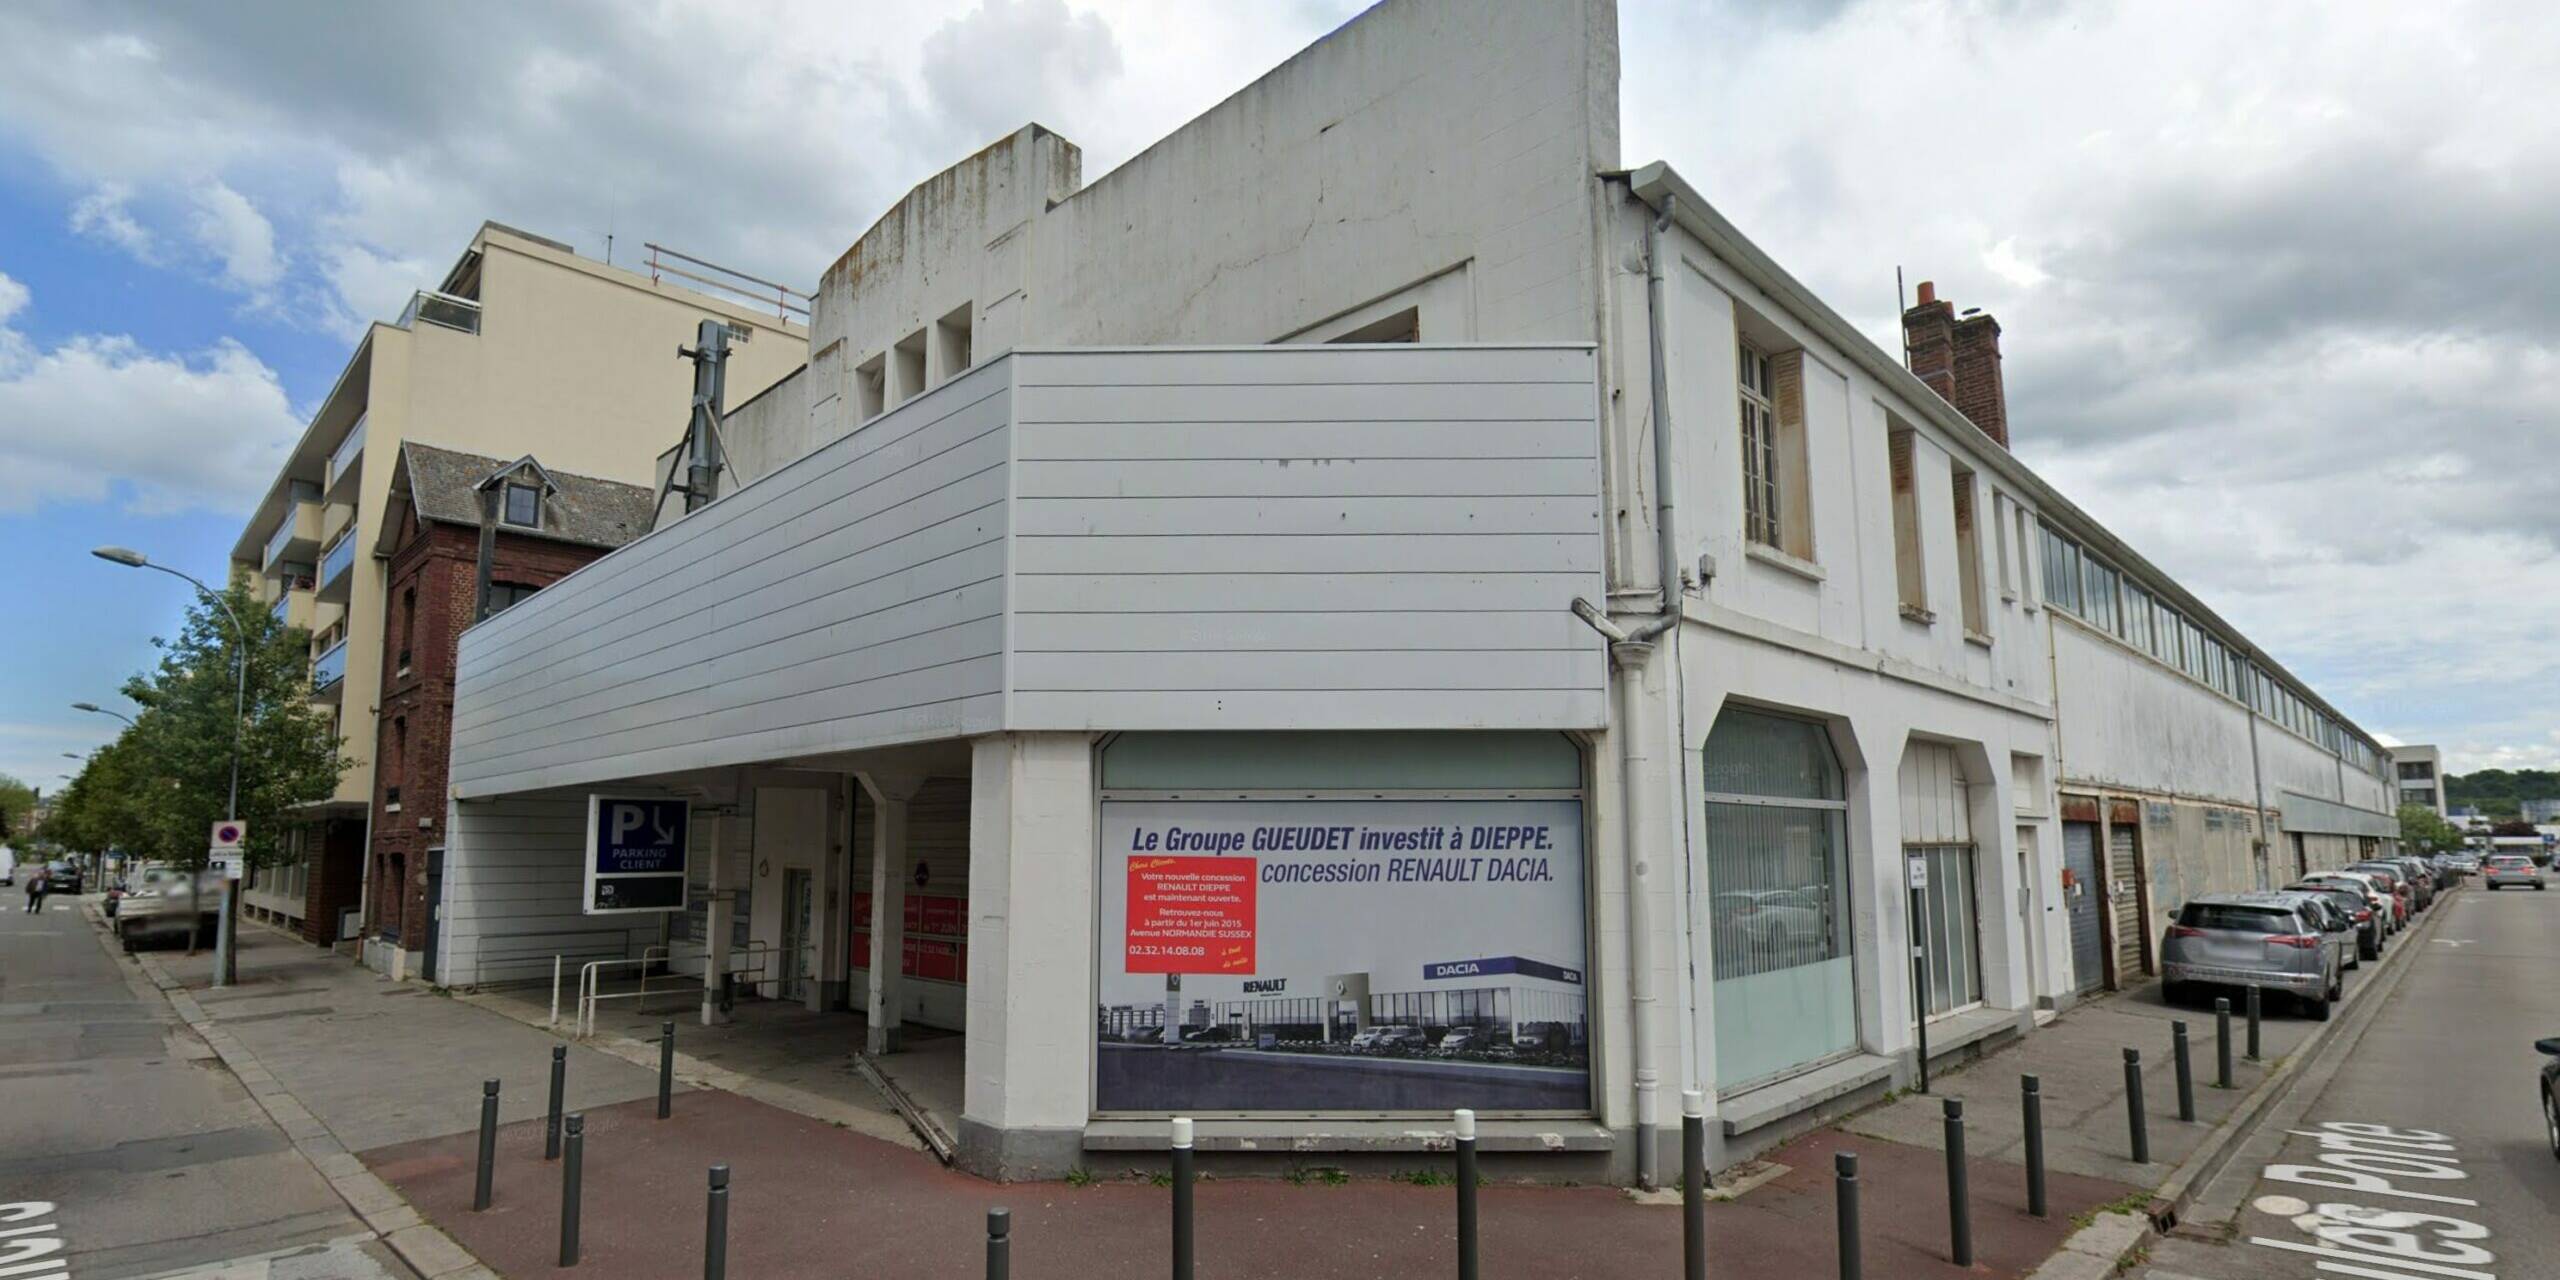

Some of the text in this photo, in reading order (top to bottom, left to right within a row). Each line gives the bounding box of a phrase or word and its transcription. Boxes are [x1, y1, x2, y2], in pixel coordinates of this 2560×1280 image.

[611, 804, 645, 845] P
[1132, 826, 1553, 856] Le Groupe GUEUDET investit à DIEPPE.
[612, 848, 667, 859] PARKING
[620, 859, 662, 870] CLIENT
[1262, 858, 1553, 883] concession RENAULT DACIA.
[1141, 872, 1245, 882] Votre nouvelle concession
[1157, 882, 1231, 892] RENAULT DIEPPE
[1143, 893, 1242, 903] est maintenant ouverte.
[1159, 907, 1224, 917] Retrouvez-nous
[1144, 919, 1242, 929] à partir du 1er juin 2015
[1130, 929, 1252, 939] Avenue NORMANDIE SUSSEX
[1129, 945, 1205, 956] 02.32.14.08.08
[1436, 963, 1480, 976] DACIA
[1562, 970, 1578, 981] DACIA
[1243, 978, 1287, 993] RENAULT
